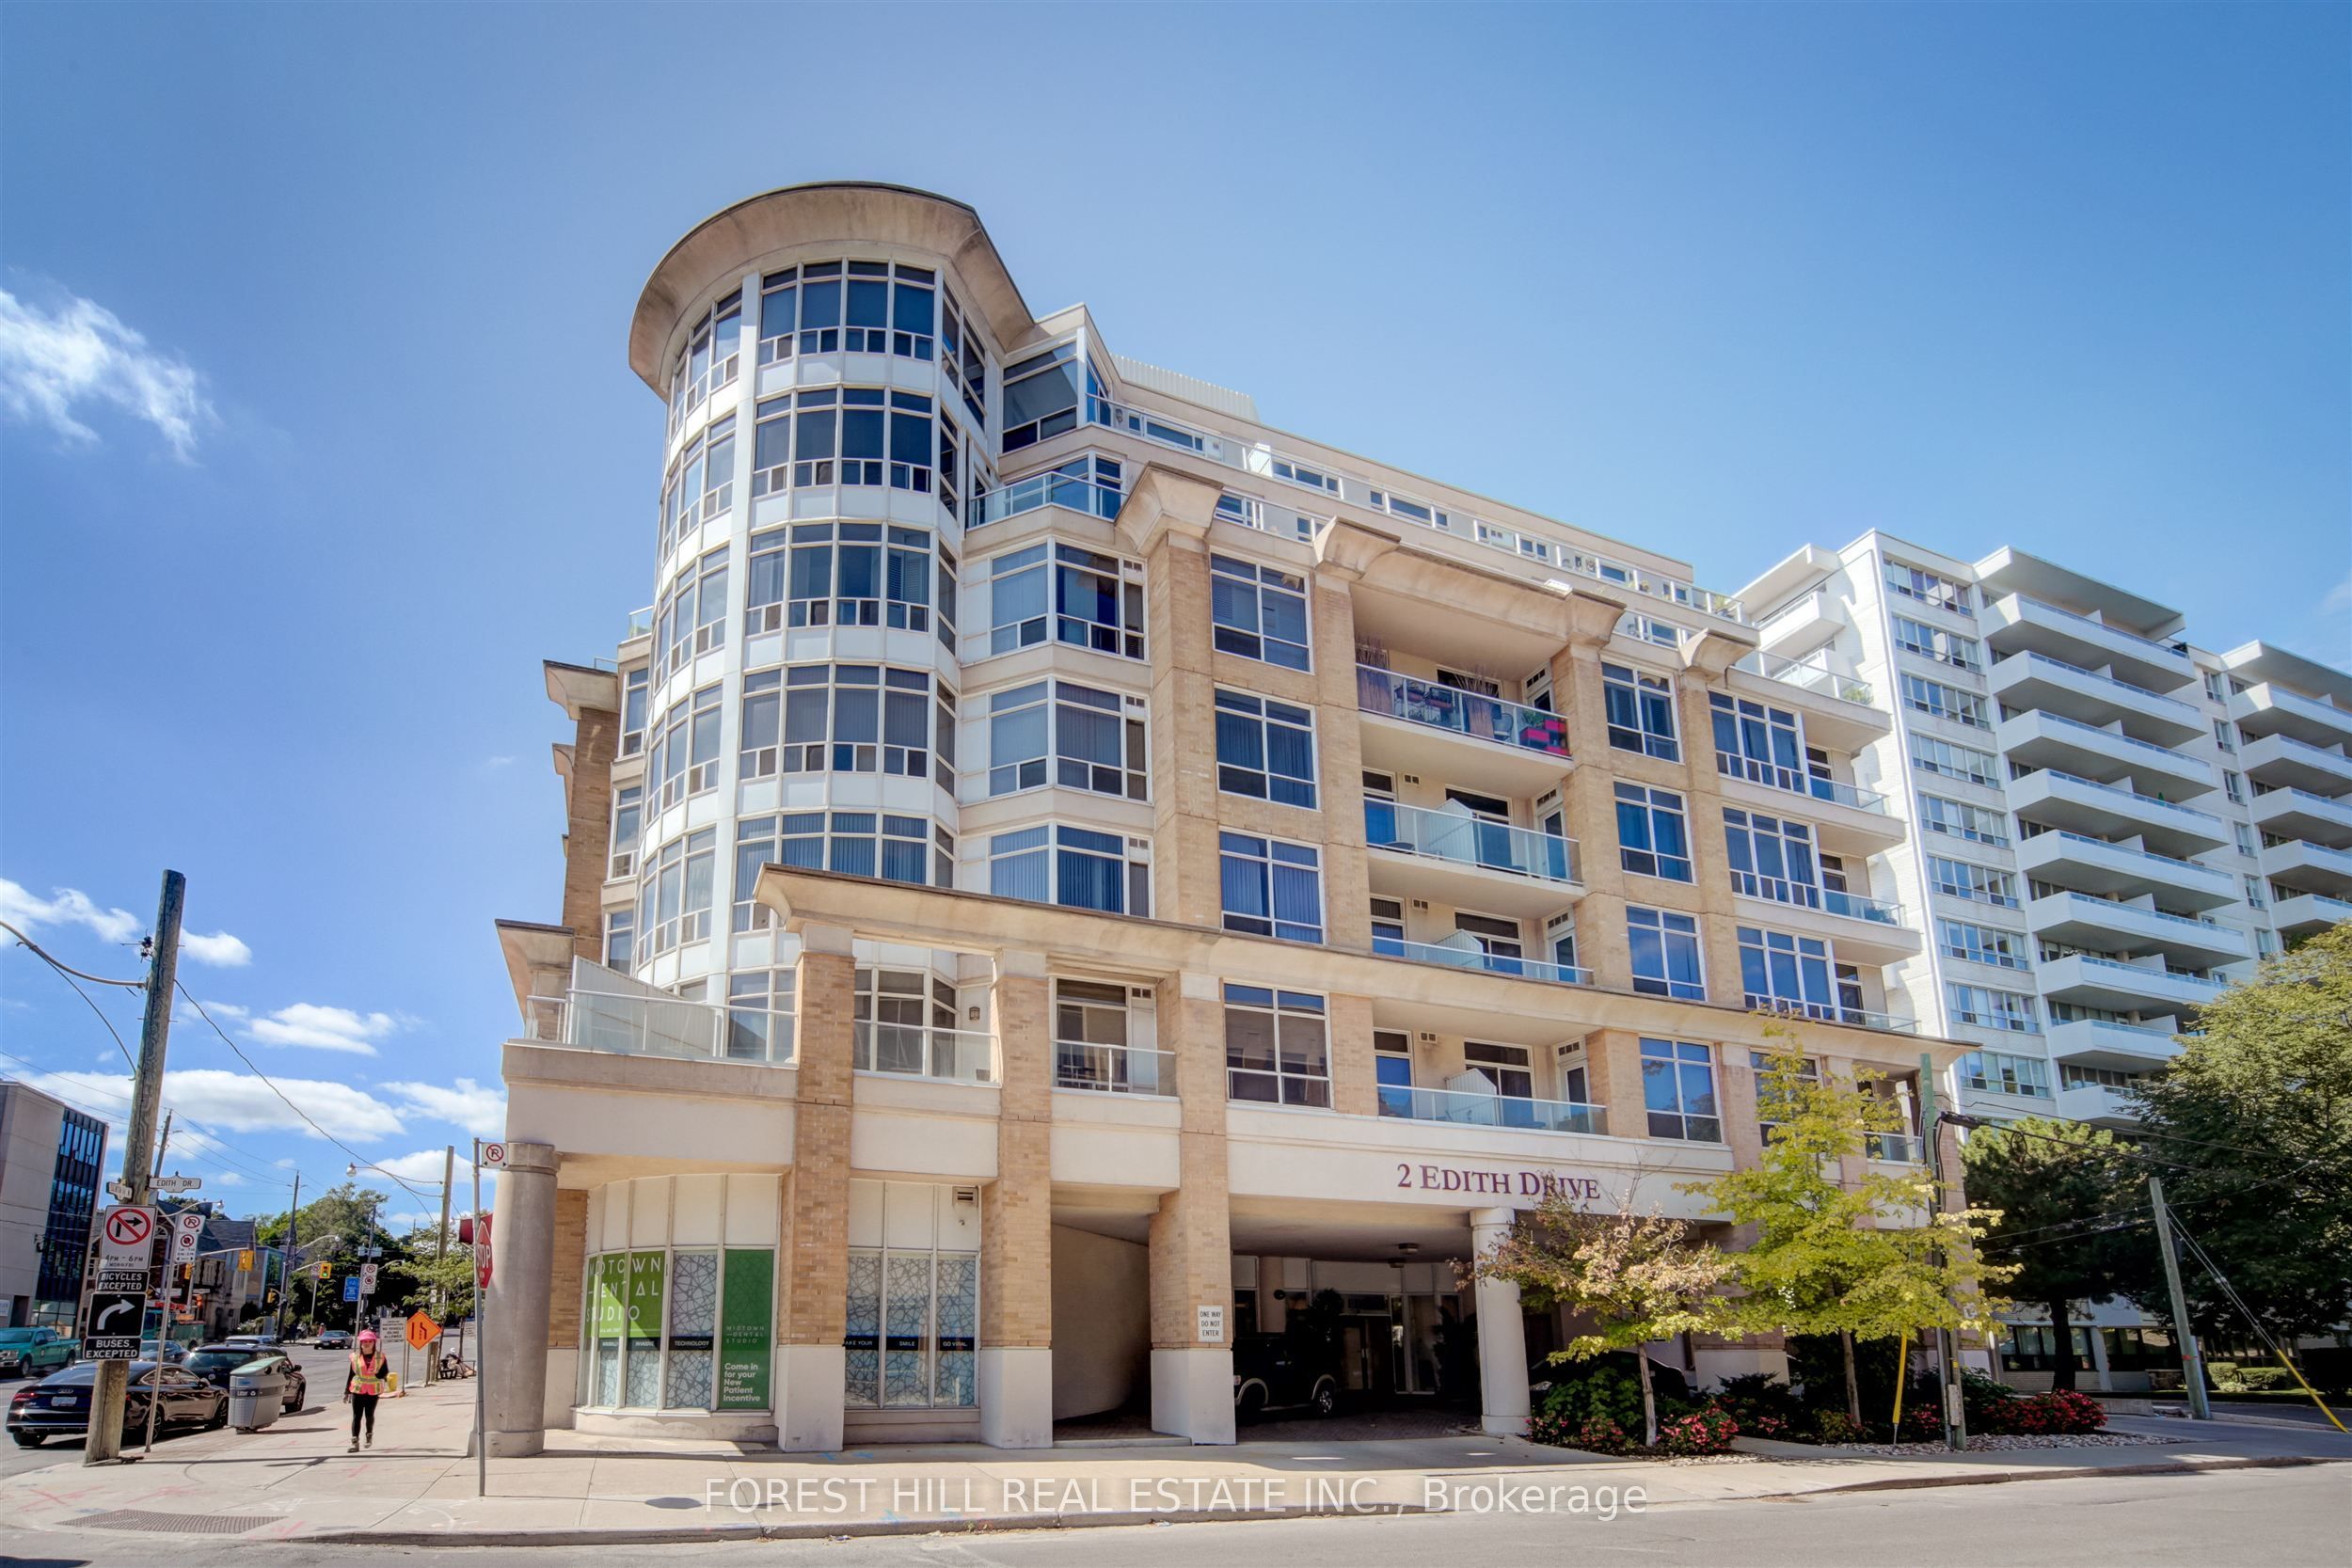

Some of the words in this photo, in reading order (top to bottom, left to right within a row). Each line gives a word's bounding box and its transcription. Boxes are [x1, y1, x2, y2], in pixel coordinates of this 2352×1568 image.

[1397, 1164, 1411, 1188] 2
[101, 1273, 142, 1281] BICYCLES
[98, 1282, 142, 1291] EXCEPTED
[95, 1339, 131, 1349] BUSES
[86, 1349, 138, 1359] EXCEPTED
[751, 1362, 758, 1370] in
[738, 1371, 756, 1380] your
